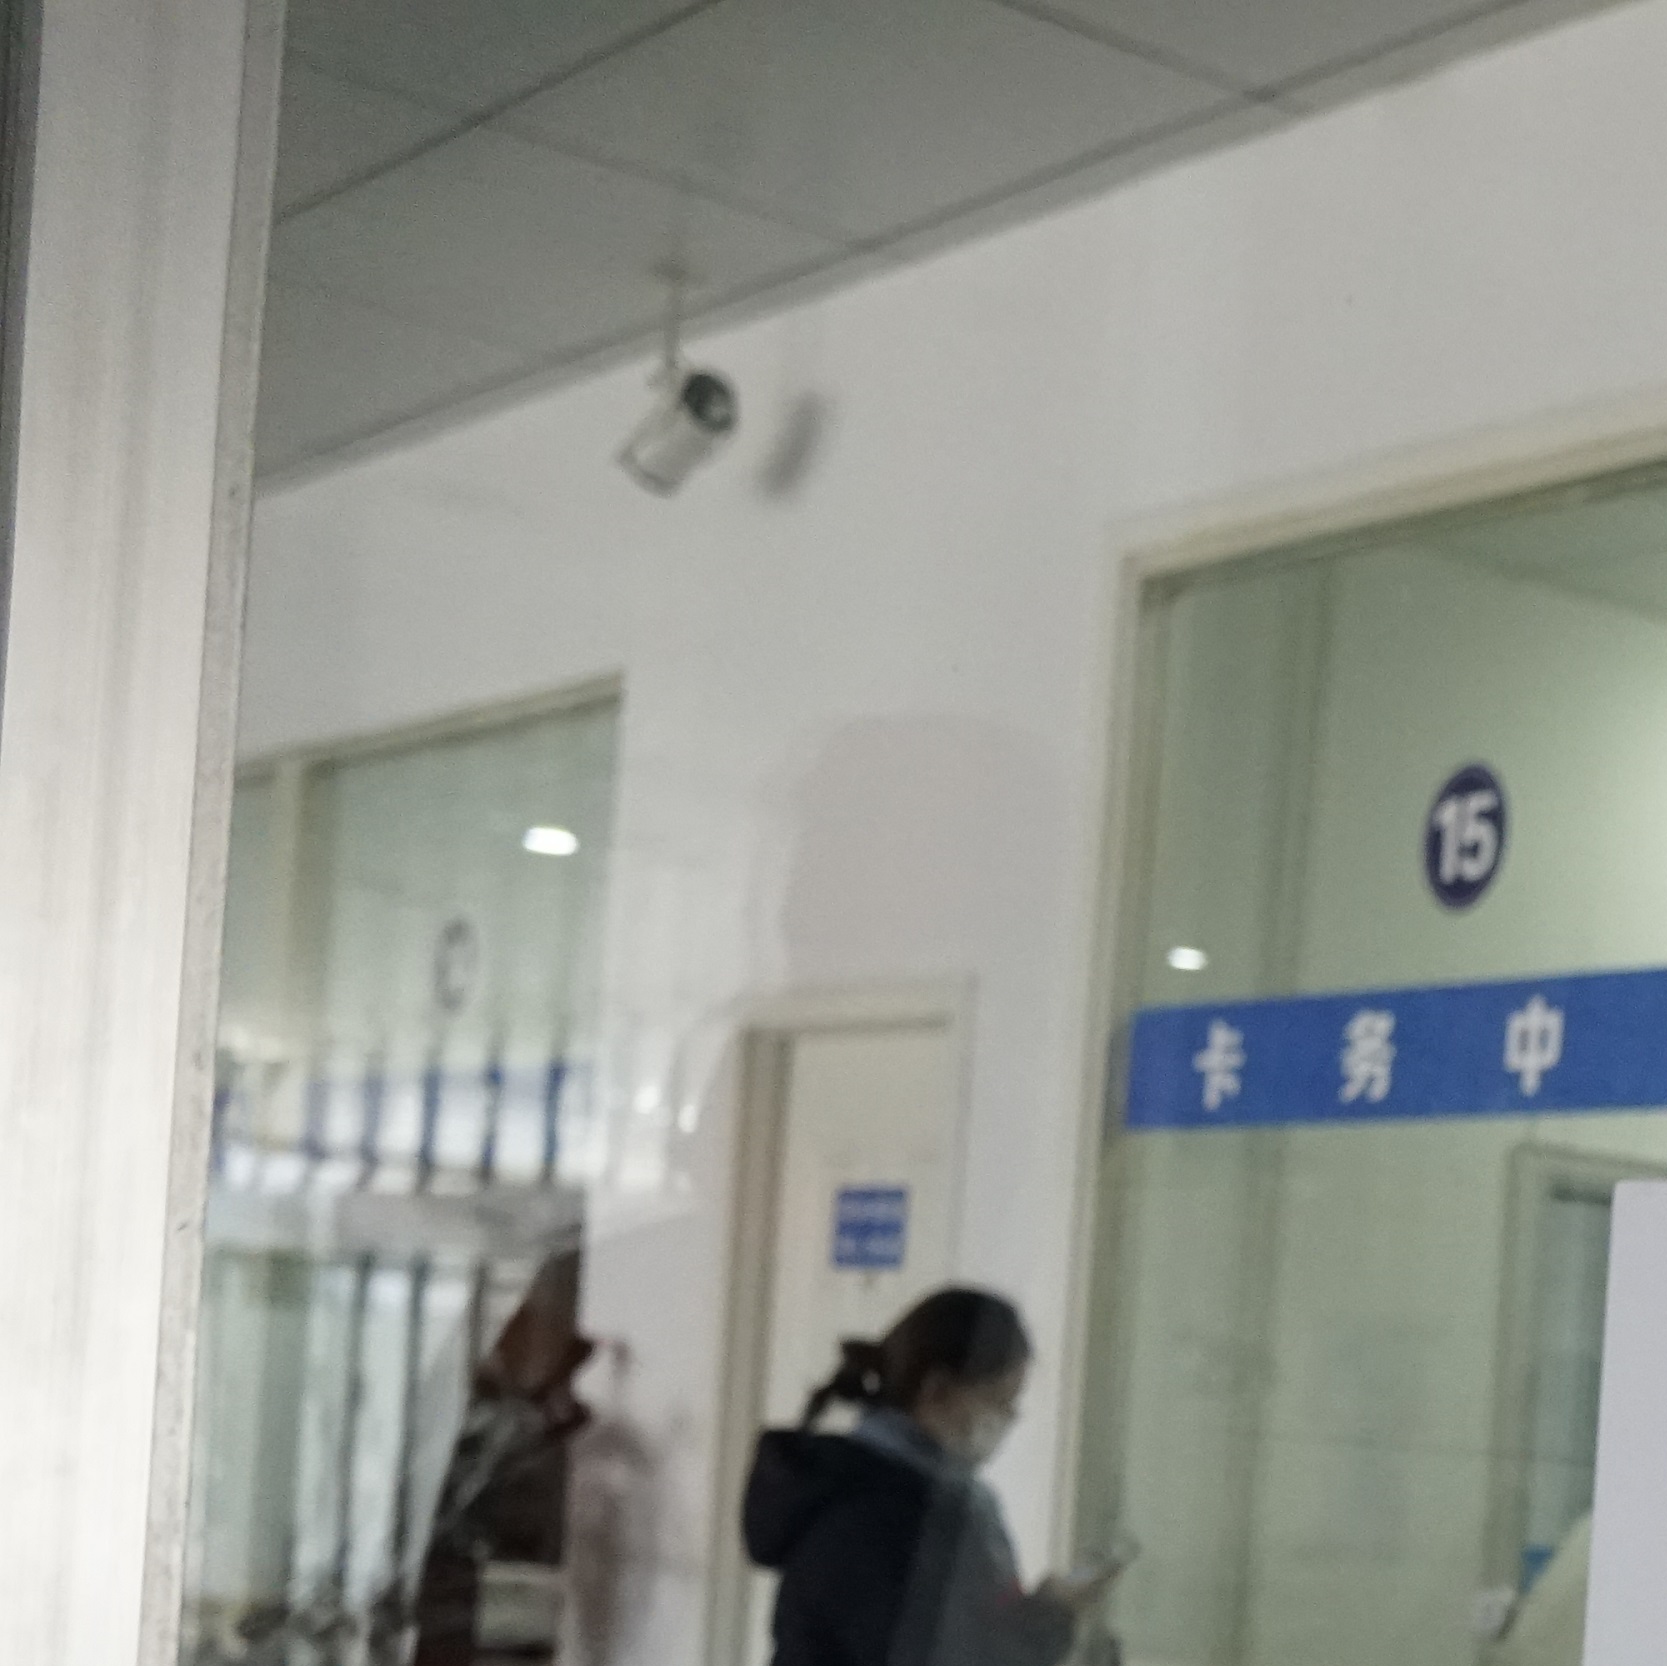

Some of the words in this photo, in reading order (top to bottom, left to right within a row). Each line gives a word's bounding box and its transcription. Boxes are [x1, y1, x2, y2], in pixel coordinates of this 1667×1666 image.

[1436, 790, 1498, 885] 15
[1193, 994, 1565, 1112] 卡务中
